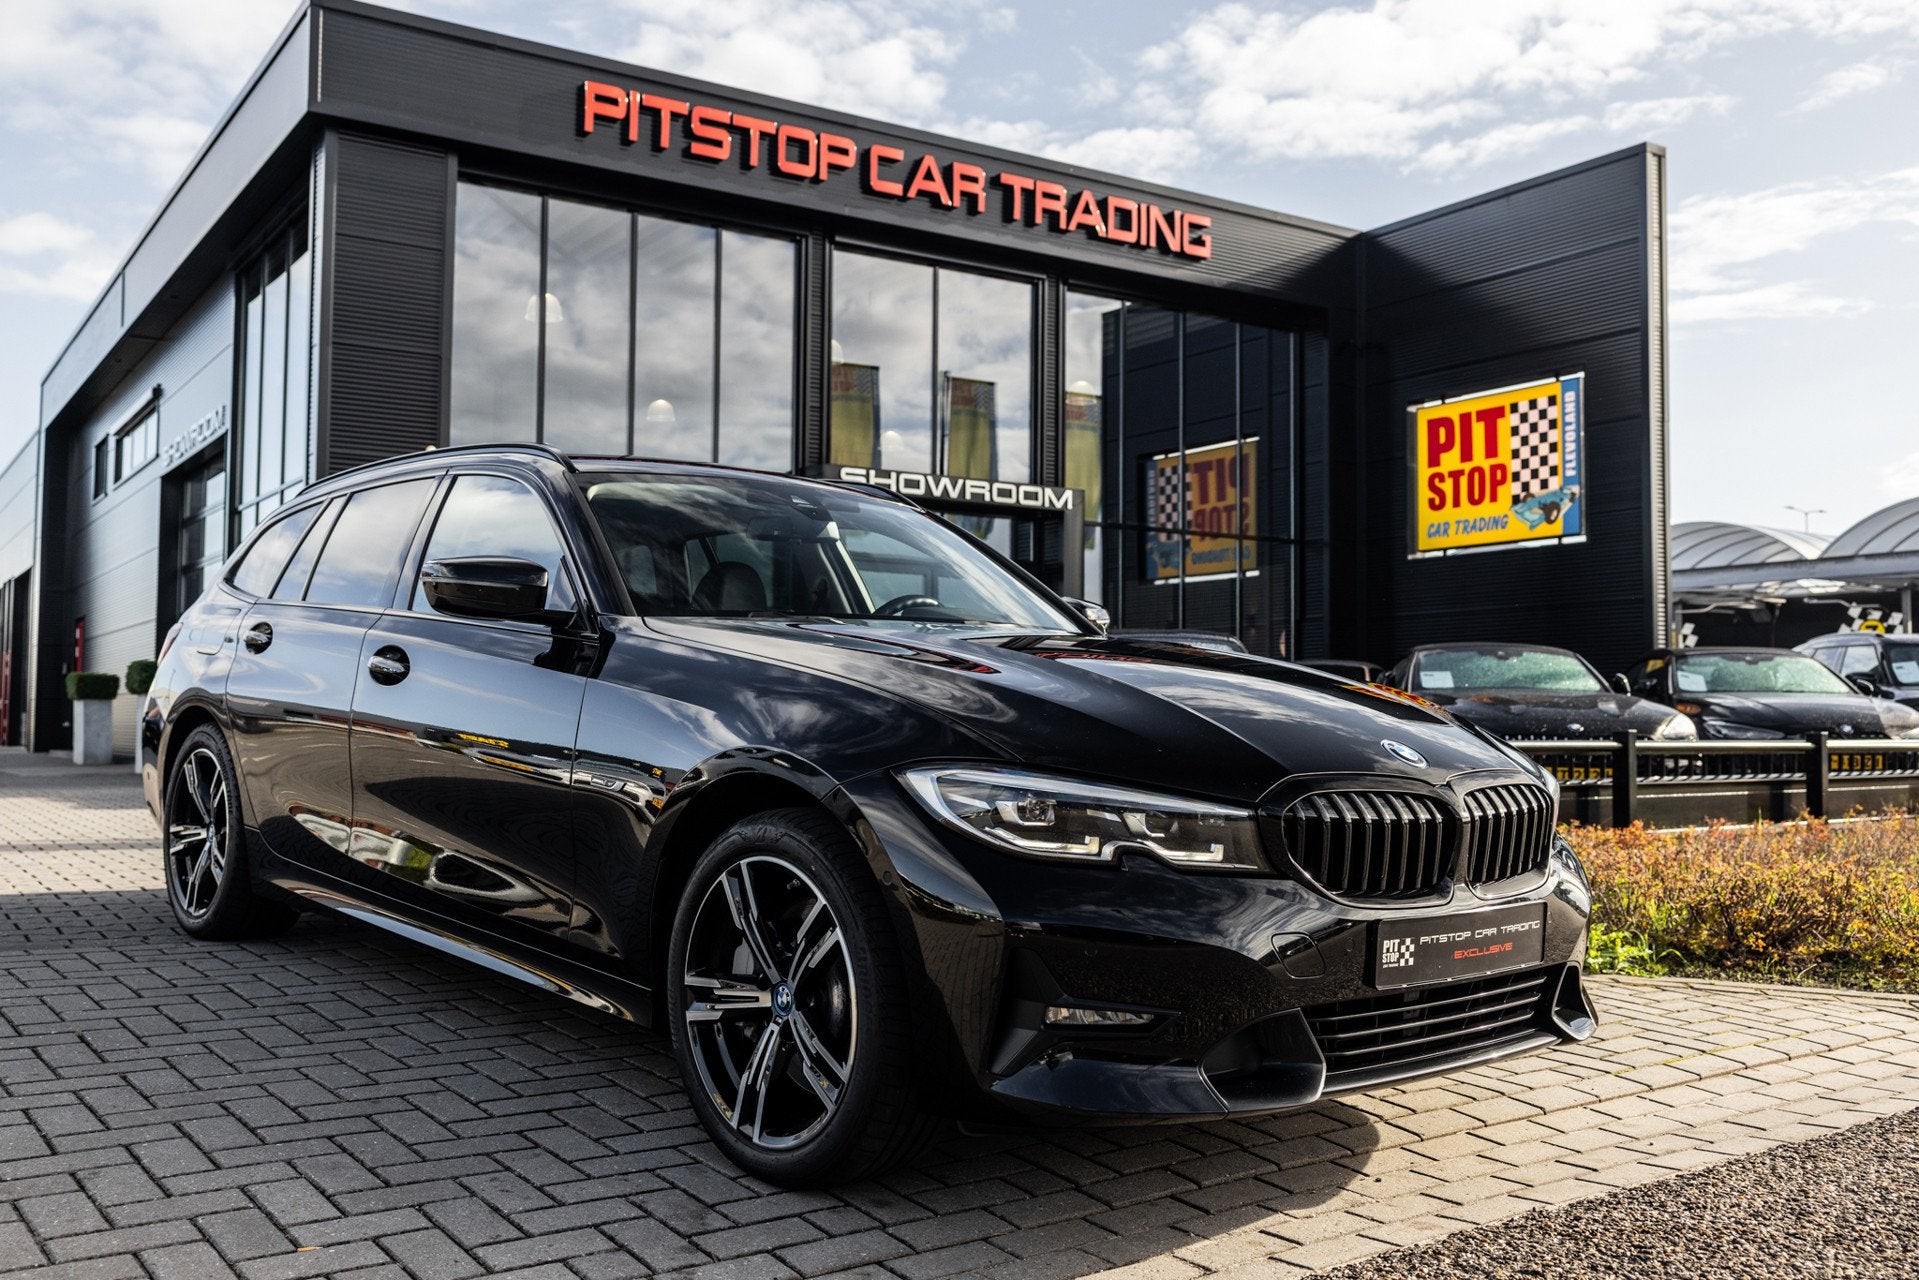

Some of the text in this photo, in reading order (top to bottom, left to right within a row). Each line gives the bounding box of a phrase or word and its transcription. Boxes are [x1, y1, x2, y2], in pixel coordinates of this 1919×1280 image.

[583, 80, 1212, 260] PITSTOP CAR TRADING
[1427, 405, 1506, 469] PIT
[1564, 390, 1577, 477] FLEVOLAND
[839, 466, 1074, 510] SHOWROOM
[1427, 463, 1508, 512] STOP
[1427, 514, 1509, 539] CAR TRADING
[1383, 939, 1401, 953] PIT
[1420, 920, 1541, 945] PITSTOP CAR TRADING
[1382, 952, 1400, 963] STOP
[1453, 942, 1513, 960] EXCLUSIVE
